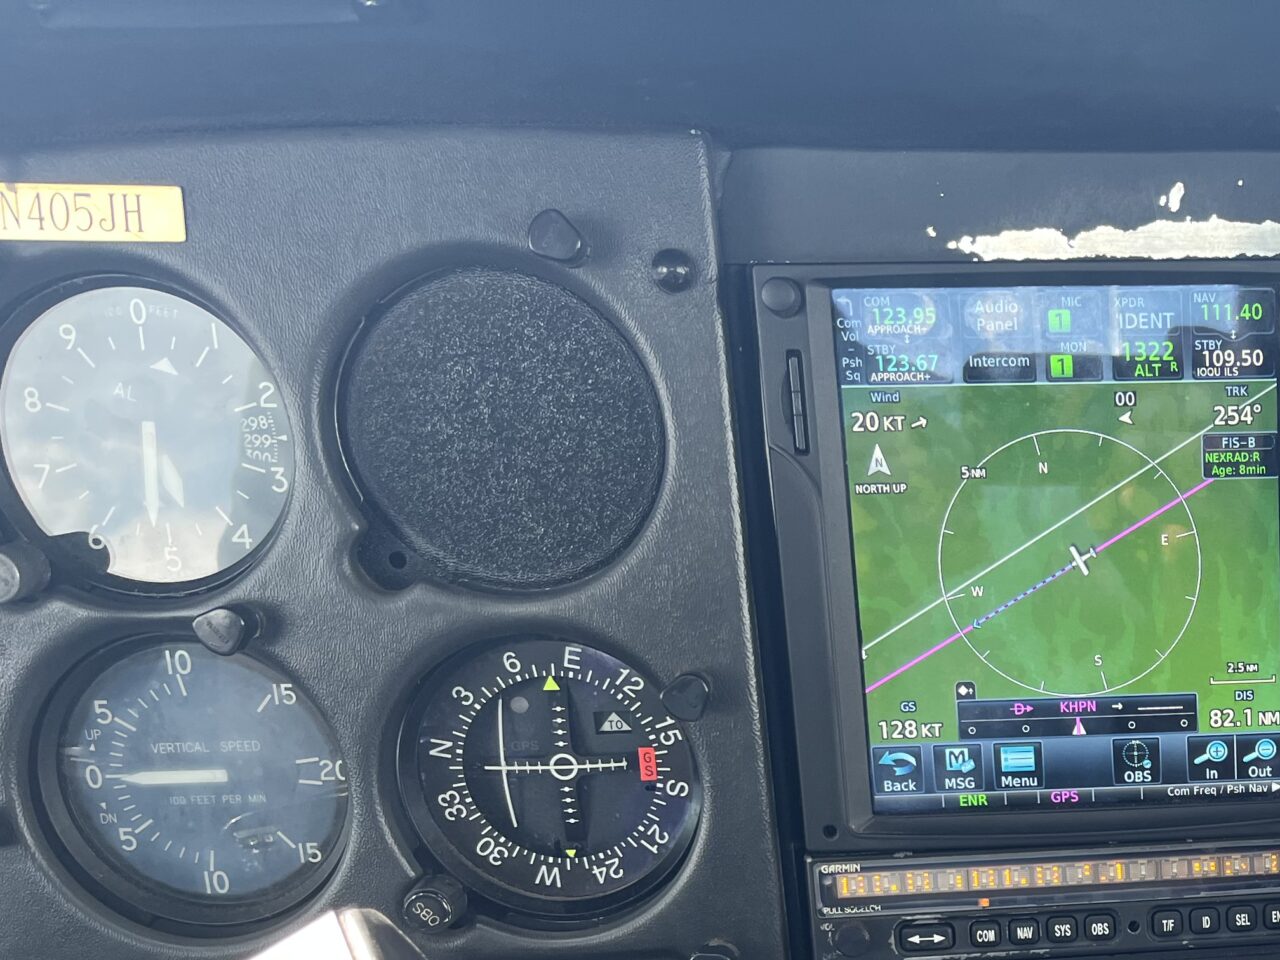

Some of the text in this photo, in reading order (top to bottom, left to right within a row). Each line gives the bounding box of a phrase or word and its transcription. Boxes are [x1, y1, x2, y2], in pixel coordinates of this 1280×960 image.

[0, 192, 144, 233] N405JH
[864, 297, 890, 307] COM
[1194, 293, 1216, 303] NAV
[975, 301, 1018, 313] Audio
[1202, 304, 1262, 320] 111.40
[873, 308, 936, 324] 123.95
[837, 318, 861, 328] Com
[977, 318, 1018, 331] Panel
[841, 332, 859, 341] Vol
[867, 345, 896, 354] STBY
[1124, 342, 1174, 361] 1322
[1195, 341, 1222, 350] STBY
[842, 358, 862, 367] Psh
[876, 355, 938, 371] 123.67
[969, 356, 1029, 367] Intercom
[1203, 350, 1263, 366] 109.50
[1135, 365, 1161, 376] ALT
[870, 391, 899, 403] Wind
[1226, 386, 1248, 397] TRK
[1214, 405, 1262, 425] 254°
[851, 412, 903, 432] 20 KT
[855, 484, 907, 494] NORTH UP
[165, 651, 191, 674] 10
[1235, 690, 1253, 701] DIS
[901, 702, 916, 712] GS
[1060, 701, 1096, 713] KHPN
[1210, 709, 1280, 727] 82.1 NM
[85, 730, 101, 740] UP
[879, 720, 942, 739] 128 KT
[151, 741, 260, 752] VERTICAL SPEED
[1124, 771, 1151, 783] OBS
[1206, 768, 1218, 779] In
[1248, 765, 1272, 778] Out
[884, 779, 917, 792] Back
[945, 778, 975, 789] MSG
[1001, 775, 1037, 787] Menu
[1051, 791, 1079, 802] GPS
[1167, 783, 1268, 798] Com Freq Psh Nav
[959, 794, 987, 806] ENR
[101, 814, 117, 823] DN
[821, 864, 860, 873] GARMIN
[1203, 917, 1210, 928] ID
[1236, 914, 1250, 925] SEL
[1017, 927, 1033, 939] NAV
[1055, 924, 1071, 936] SYS
[1092, 923, 1109, 935] OBS
[977, 930, 995, 942] COM
